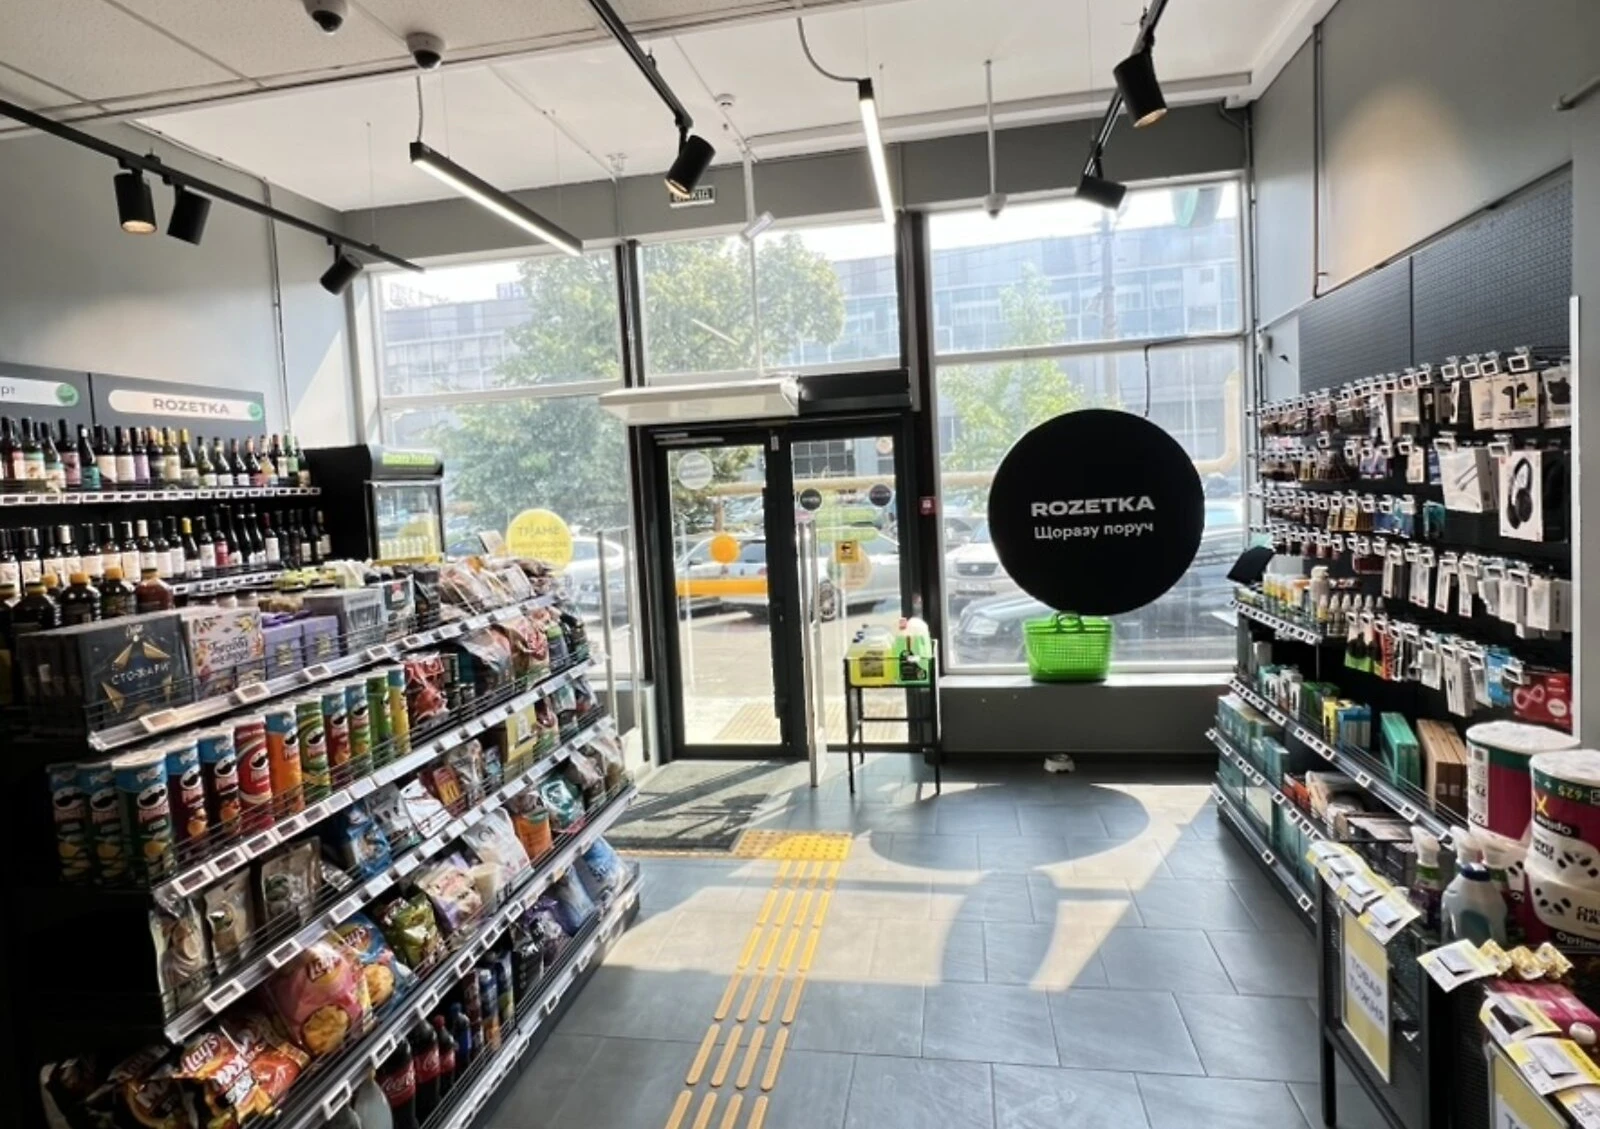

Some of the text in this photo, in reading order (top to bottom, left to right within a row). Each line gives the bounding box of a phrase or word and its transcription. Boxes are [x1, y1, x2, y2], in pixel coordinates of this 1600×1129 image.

[152, 397, 230, 415] ROZETKA
[1031, 495, 1156, 517] ROZETKA
[1034, 521, 1154, 540] Щоразу поруч
[111, 663, 170, 685] СТОЖАРИ
[1350, 955, 1382, 997] ТОВАР
